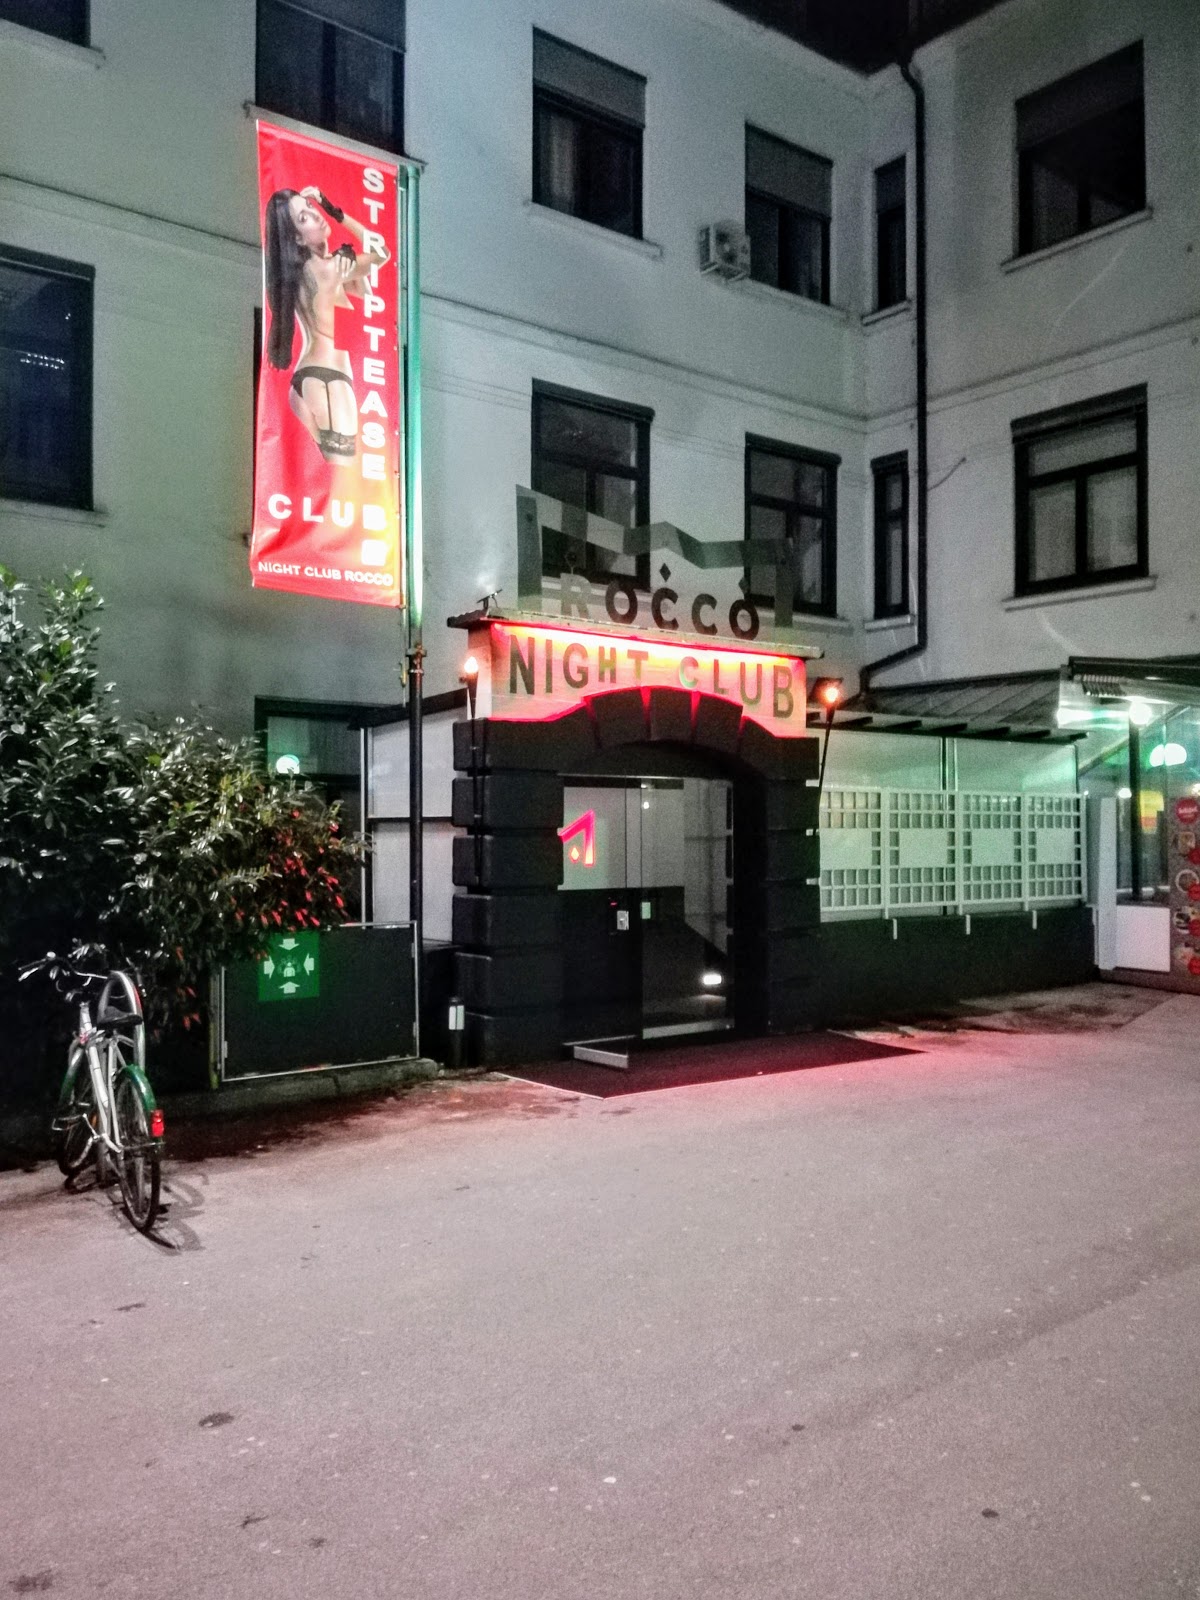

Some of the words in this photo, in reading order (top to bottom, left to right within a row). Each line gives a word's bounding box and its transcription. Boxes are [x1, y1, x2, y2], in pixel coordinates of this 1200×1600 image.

[360, 167, 387, 481] STRIPTEASE
[257, 561, 302, 576] NIGHT
[304, 566, 342, 580] CLUB
[345, 570, 394, 586] ROCCO
[559, 572, 760, 641] ROCCO
[508, 634, 649, 695] NIGHT
[678, 656, 795, 719] CLUB
